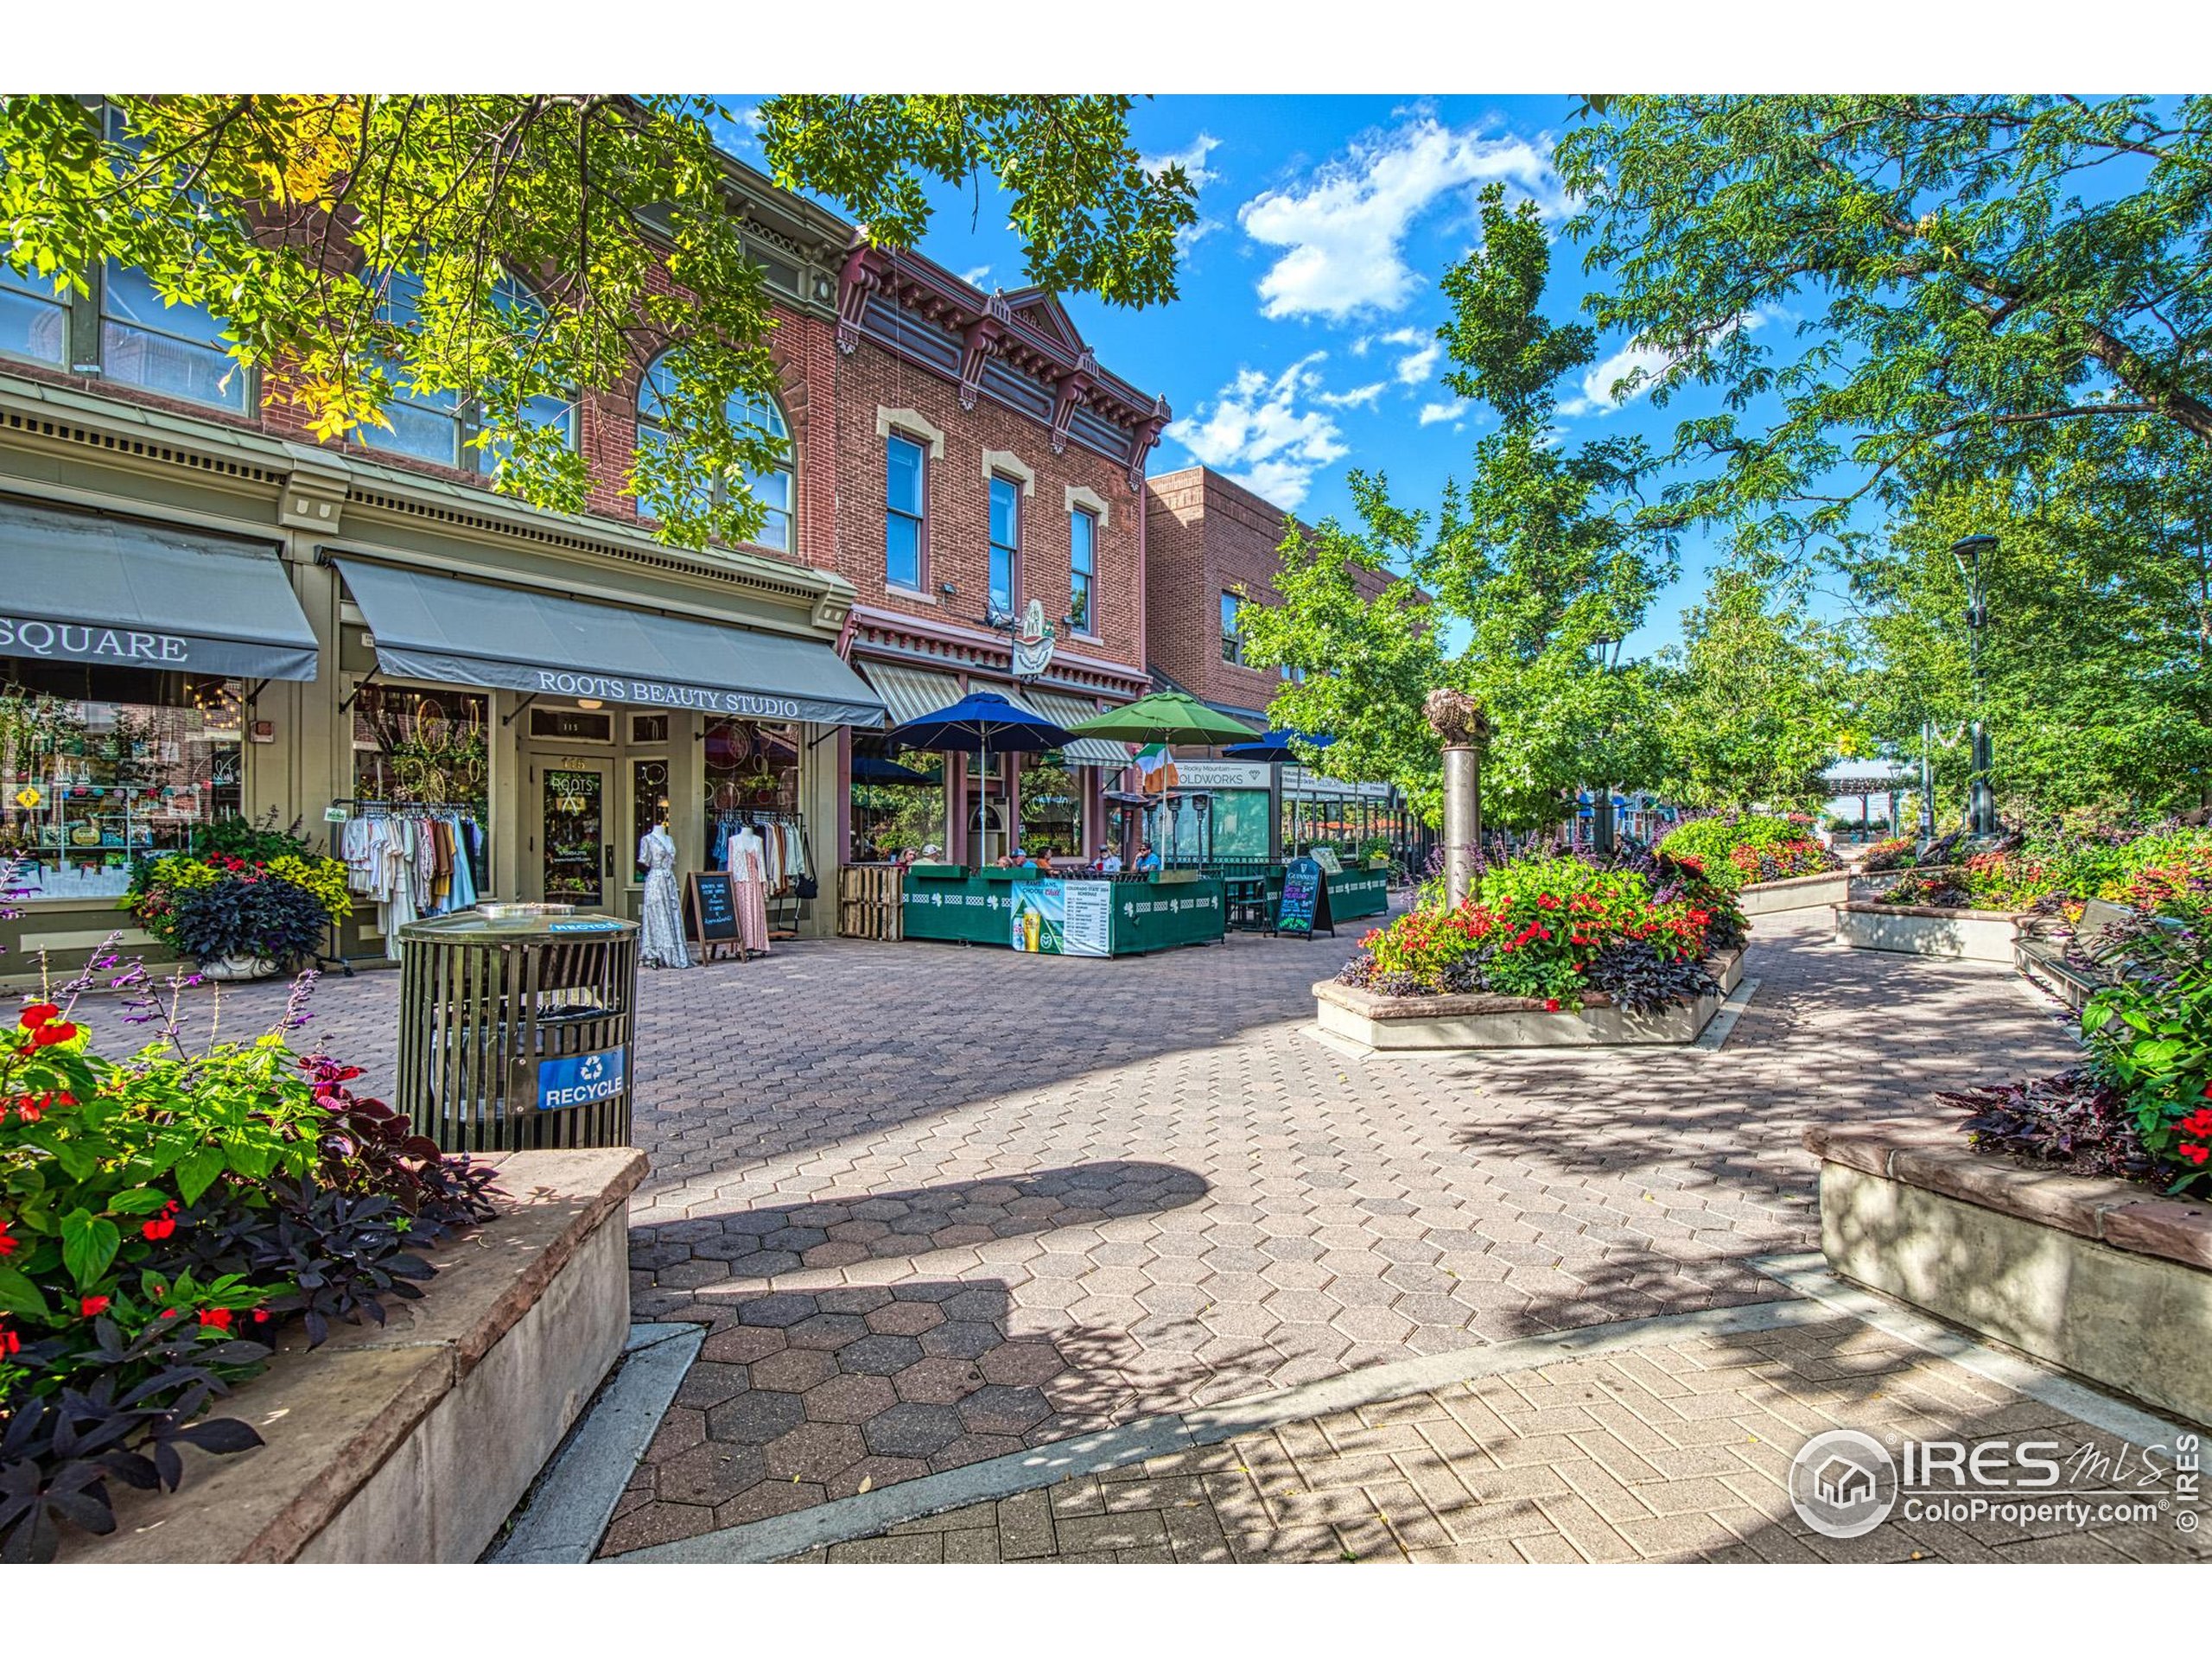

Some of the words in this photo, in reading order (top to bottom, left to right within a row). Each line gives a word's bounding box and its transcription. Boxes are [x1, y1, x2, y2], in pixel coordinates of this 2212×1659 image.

[537, 671, 624, 698] ROOTS
[632, 683, 719, 709] BEAUTY
[727, 694, 798, 717] STUDIO
[552, 777, 593, 791] ROOTS
[1179, 774, 1243, 785] OLDWORKS
[545, 1077, 622, 1106] RECYCLE
